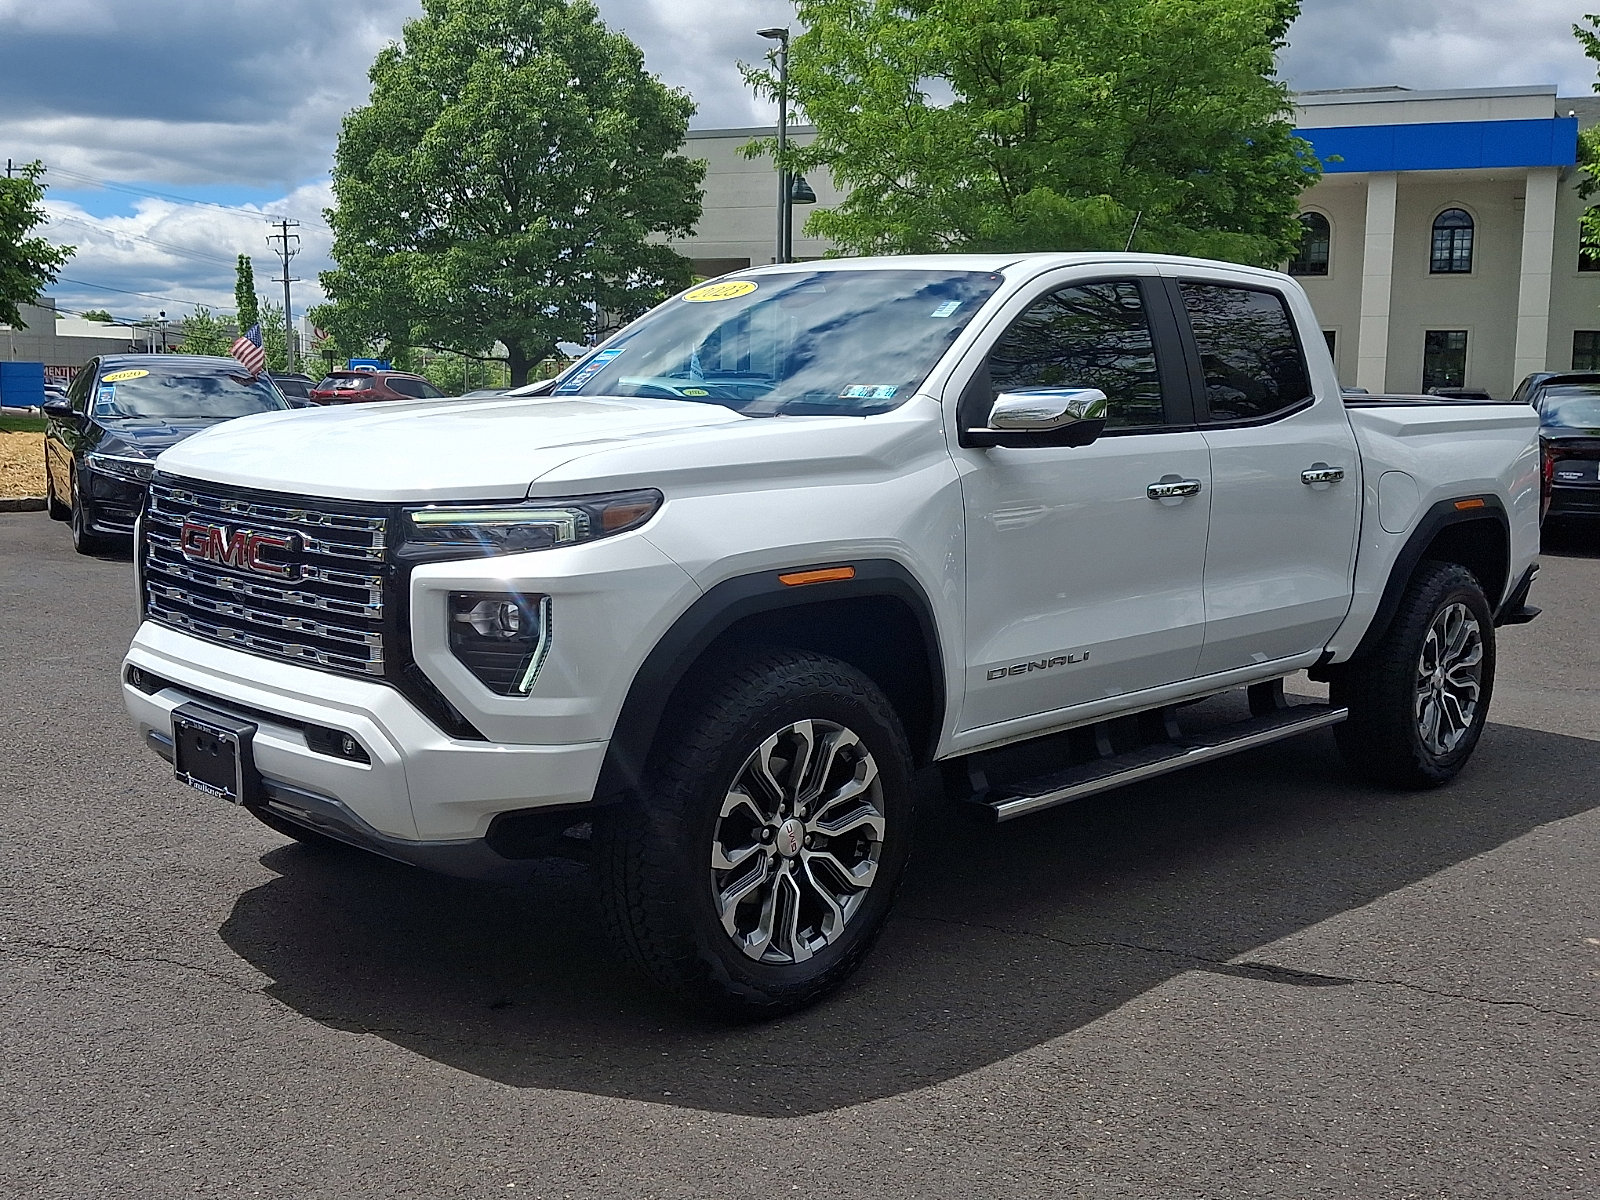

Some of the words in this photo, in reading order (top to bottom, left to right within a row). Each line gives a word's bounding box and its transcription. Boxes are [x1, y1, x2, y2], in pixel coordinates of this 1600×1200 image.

[111, 371, 141, 381] 2020
[181, 522, 297, 577] GMC
[987, 650, 1090, 681] DENALI
[188, 777, 223, 798] Faulkner
[786, 823, 797, 853] GMC
